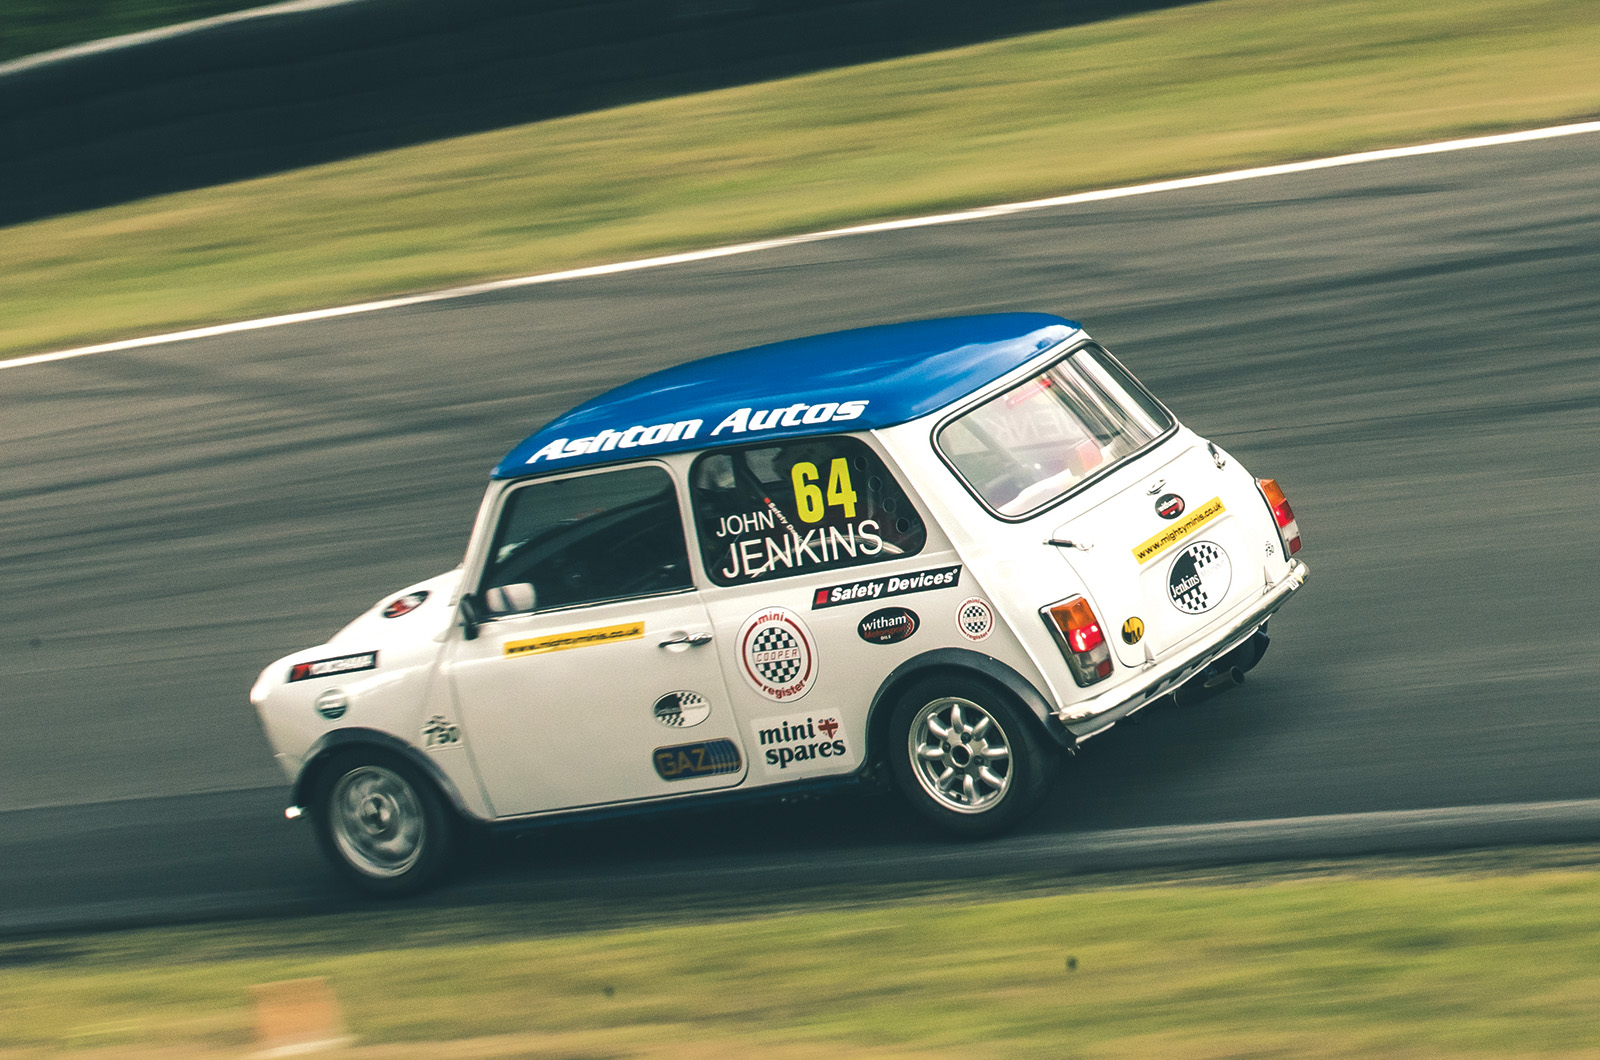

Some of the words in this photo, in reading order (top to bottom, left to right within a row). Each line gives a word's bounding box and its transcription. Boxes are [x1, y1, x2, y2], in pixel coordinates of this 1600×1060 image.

[525, 418, 703, 465] Ashton
[710, 399, 870, 436] Autos
[790, 457, 858, 524] 64
[716, 509, 775, 538] JOHN
[1137, 502, 1223, 559] www.mightyminis.co.uk
[722, 519, 884, 579] JENKINS
[830, 582, 884, 602] Safety
[1170, 574, 1201, 599] Jenkins
[757, 611, 785, 625] mini
[862, 615, 907, 632] witham
[756, 648, 799, 662] COOPER
[762, 680, 806, 699] register
[758, 717, 816, 745] mini
[656, 748, 706, 776] GAZ
[765, 739, 847, 769] spares
